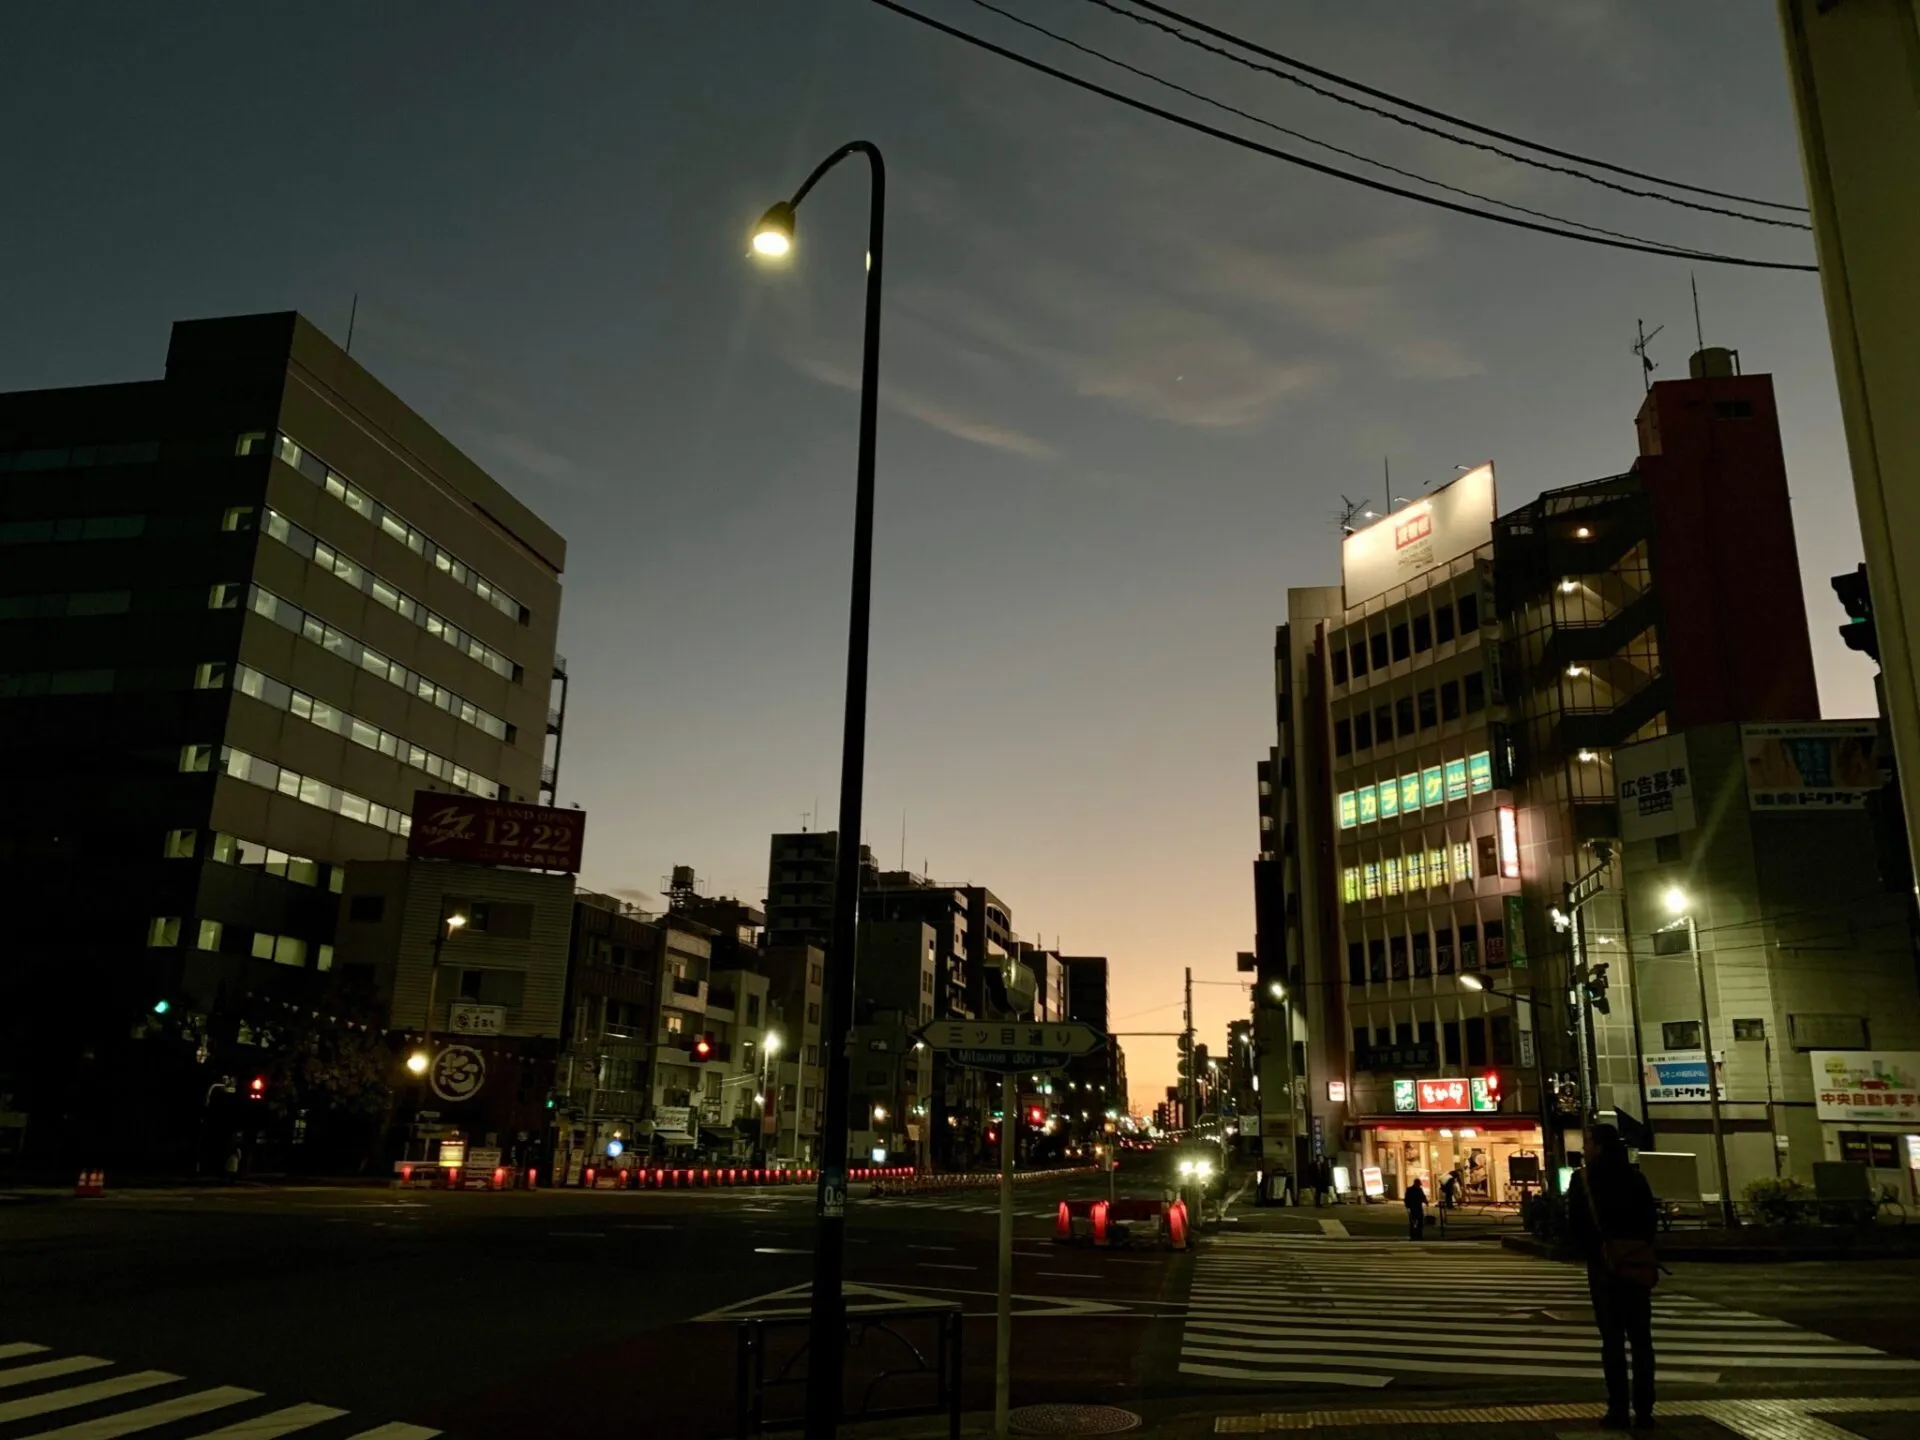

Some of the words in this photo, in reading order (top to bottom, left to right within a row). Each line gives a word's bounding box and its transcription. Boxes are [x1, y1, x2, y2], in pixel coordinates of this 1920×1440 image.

[950, 1026, 1071, 1047] 三ツ目通り
[1821, 1093, 1920, 1107] 中央自動車学
